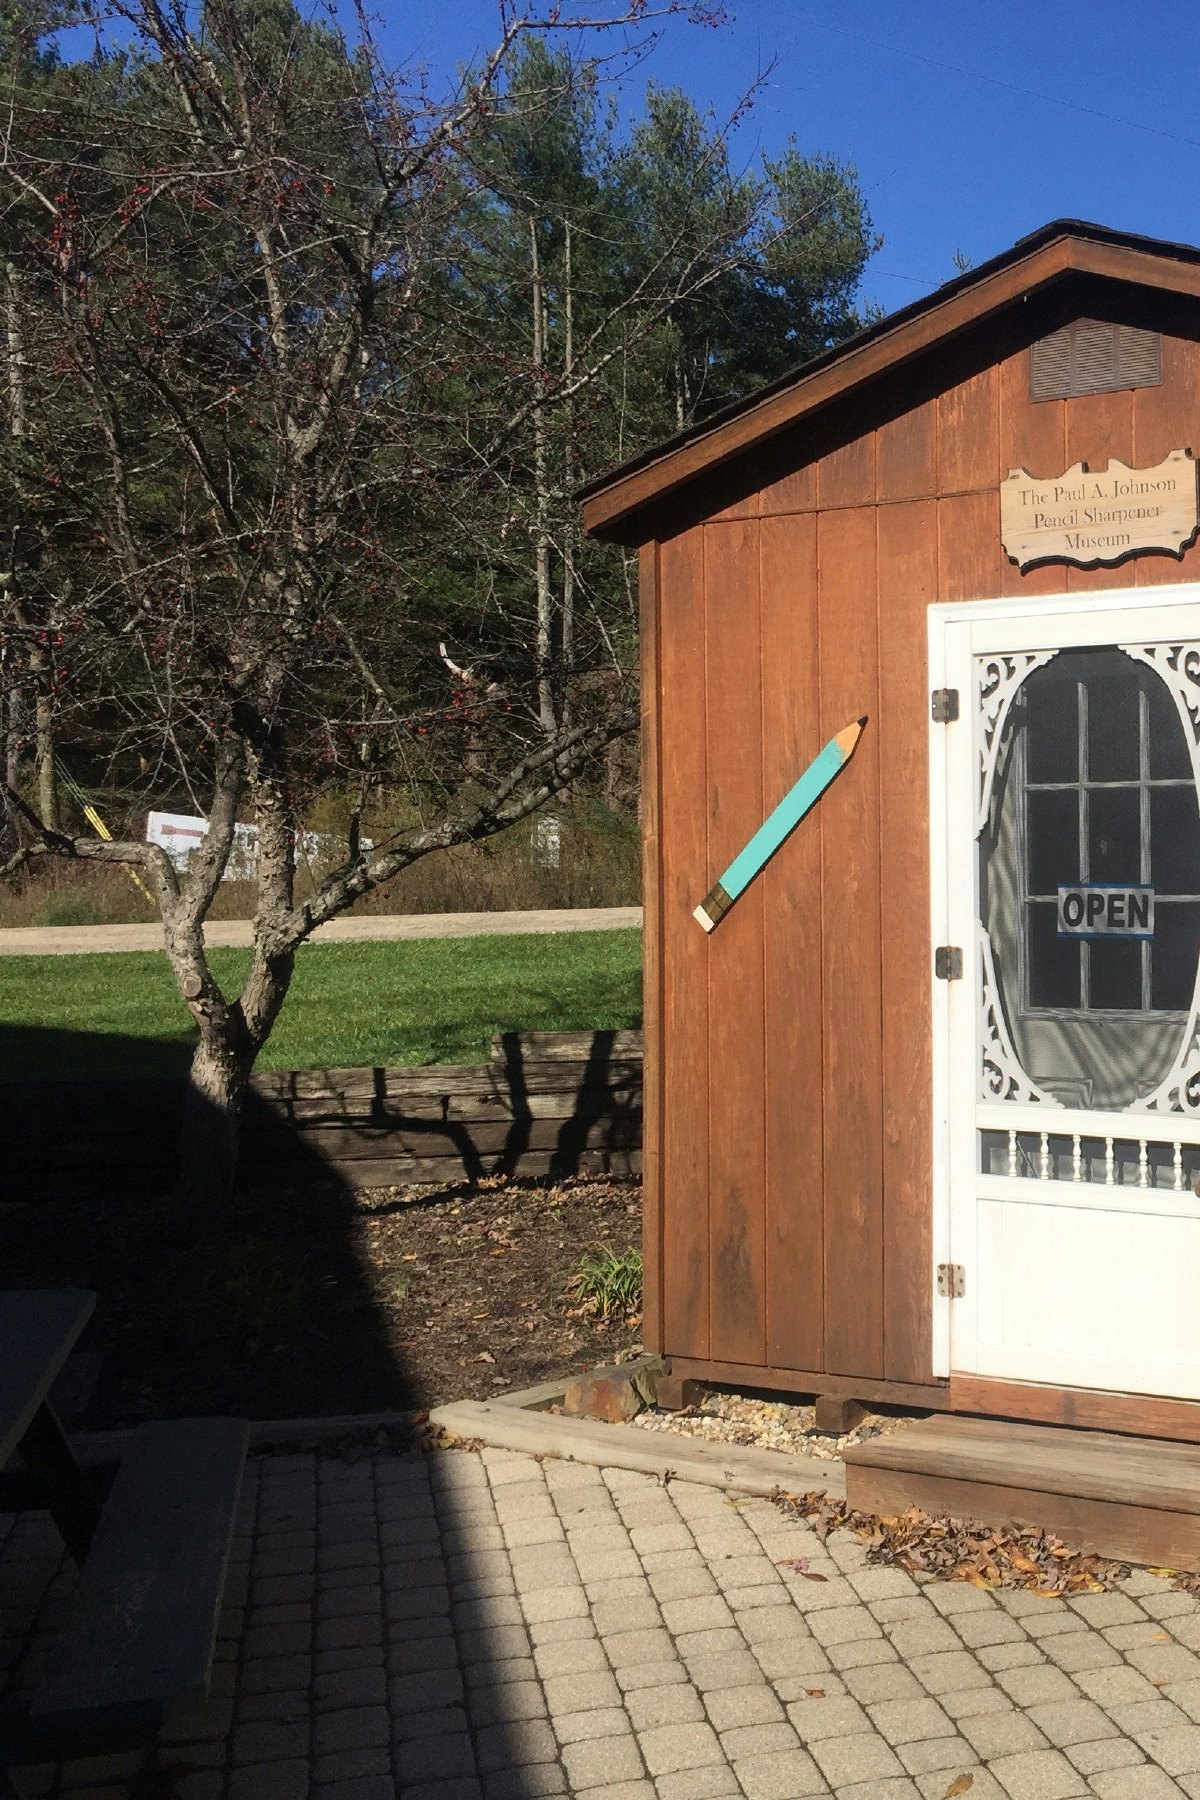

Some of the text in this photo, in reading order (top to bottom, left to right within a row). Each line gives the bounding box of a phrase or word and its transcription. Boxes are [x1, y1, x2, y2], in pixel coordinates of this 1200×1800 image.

[1018, 478, 1177, 506] The Paul A. Johnson
[1033, 505, 1162, 529] Pencil Sharpener
[1065, 533, 1131, 550] Museum
[1063, 893, 1148, 928] OPEN
